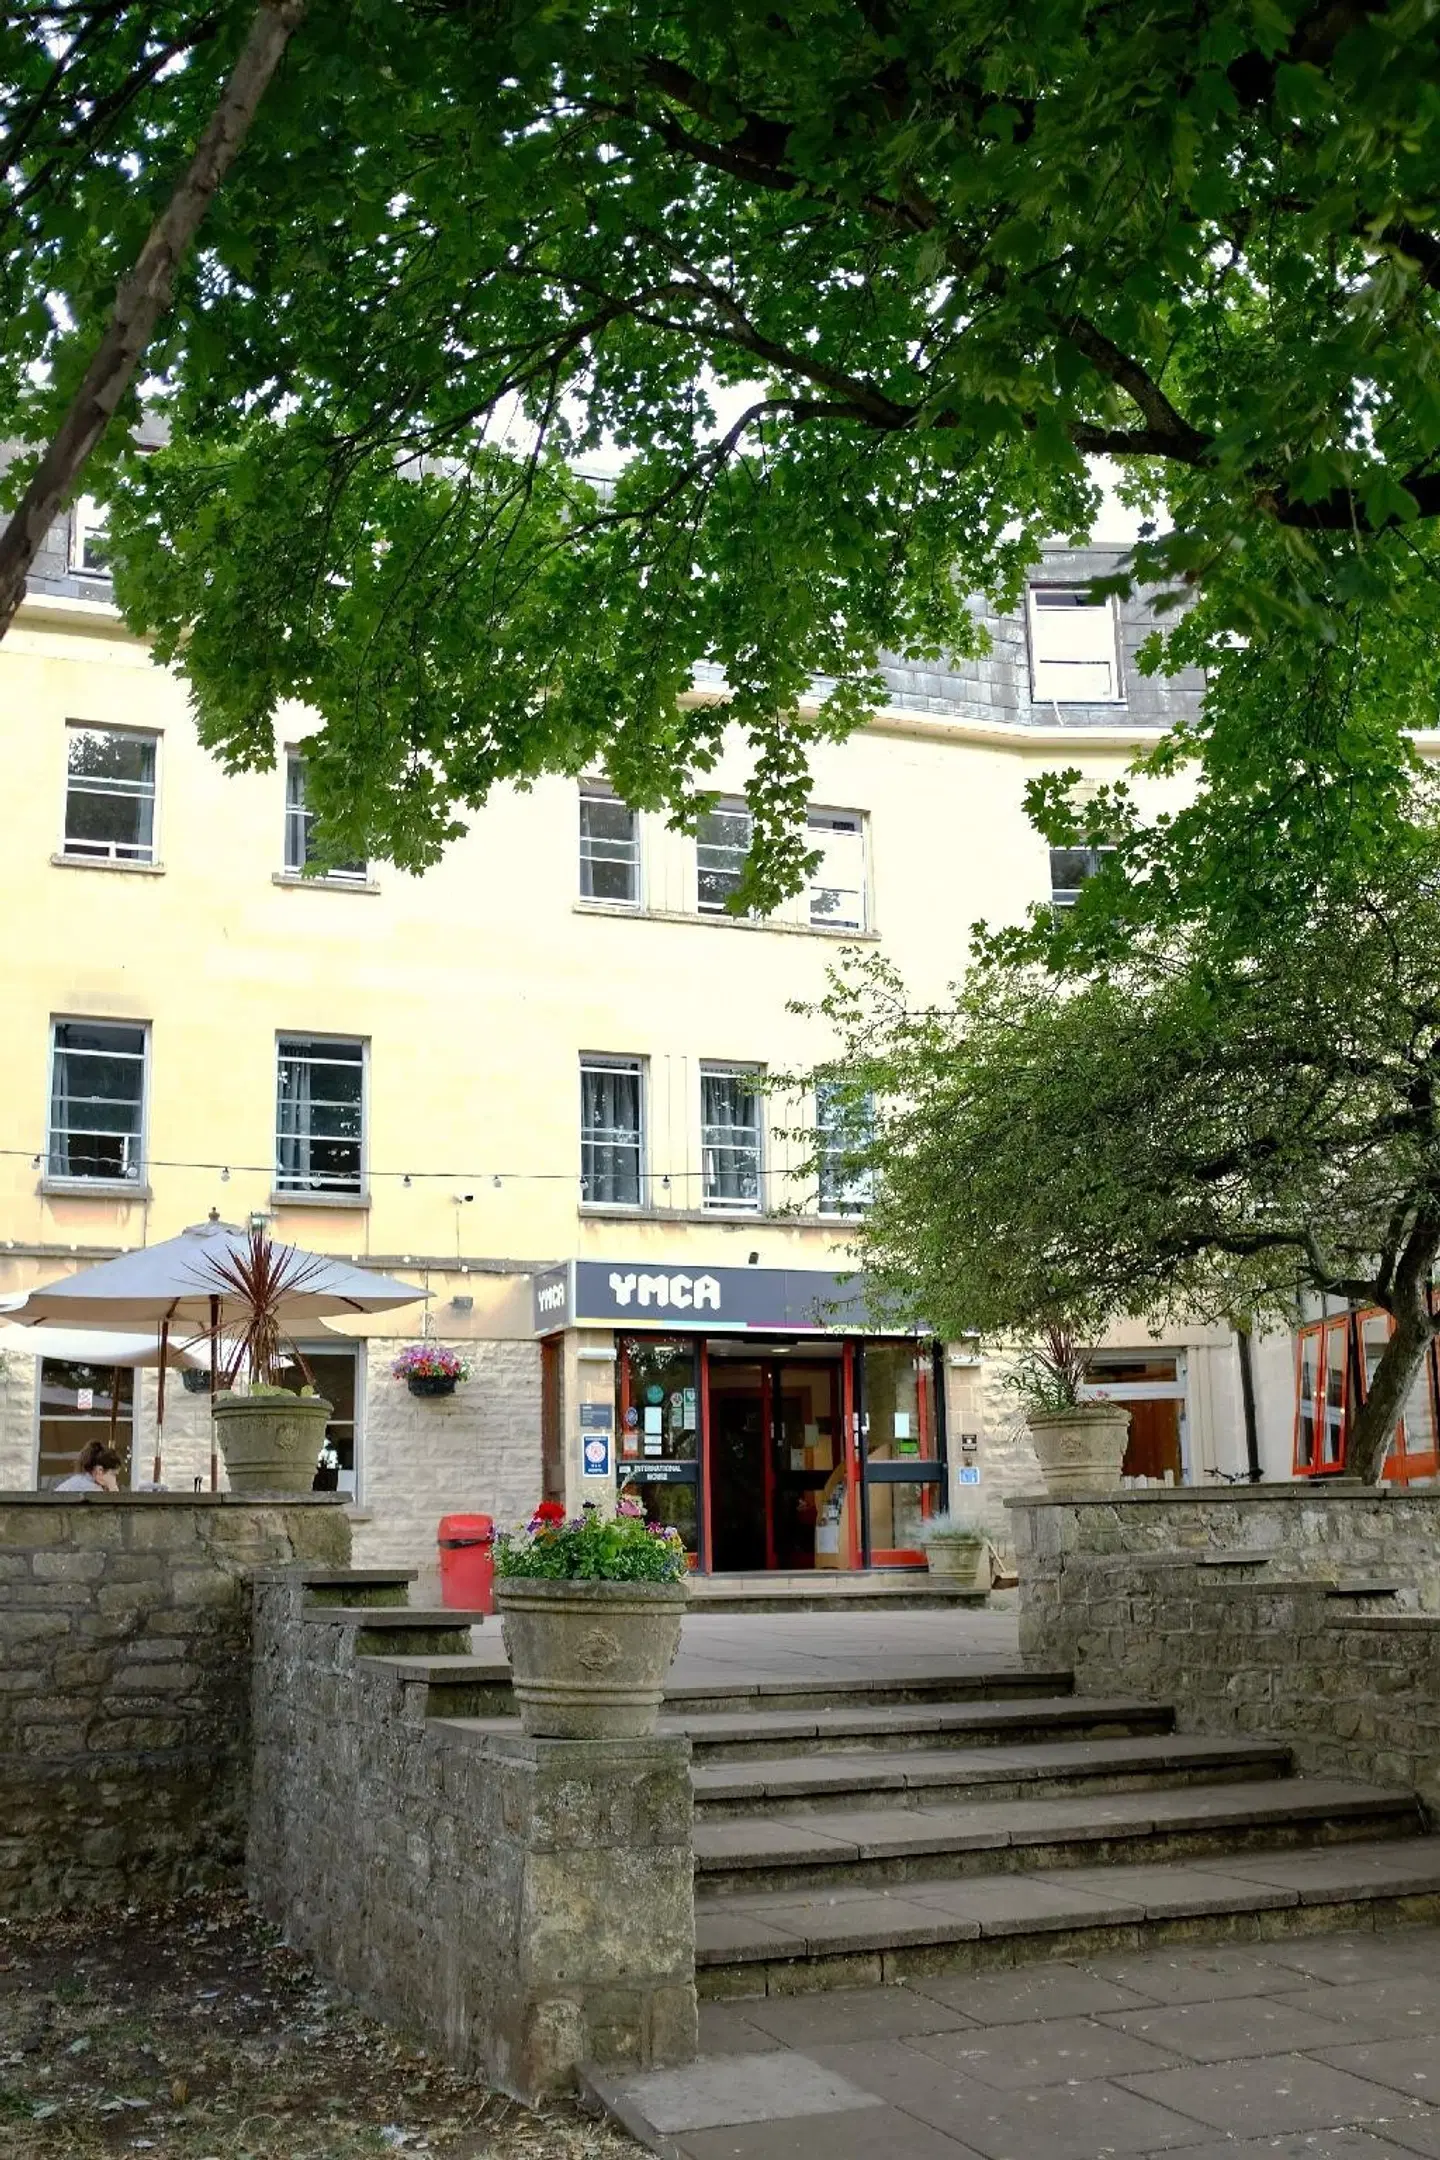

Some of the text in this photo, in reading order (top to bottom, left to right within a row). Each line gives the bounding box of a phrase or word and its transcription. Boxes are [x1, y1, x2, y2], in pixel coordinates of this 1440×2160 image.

[538, 1283, 565, 1312] YMCA
[609, 1272, 721, 1310] YMCA
[634, 1464, 682, 1472] INTERNATIONAL
